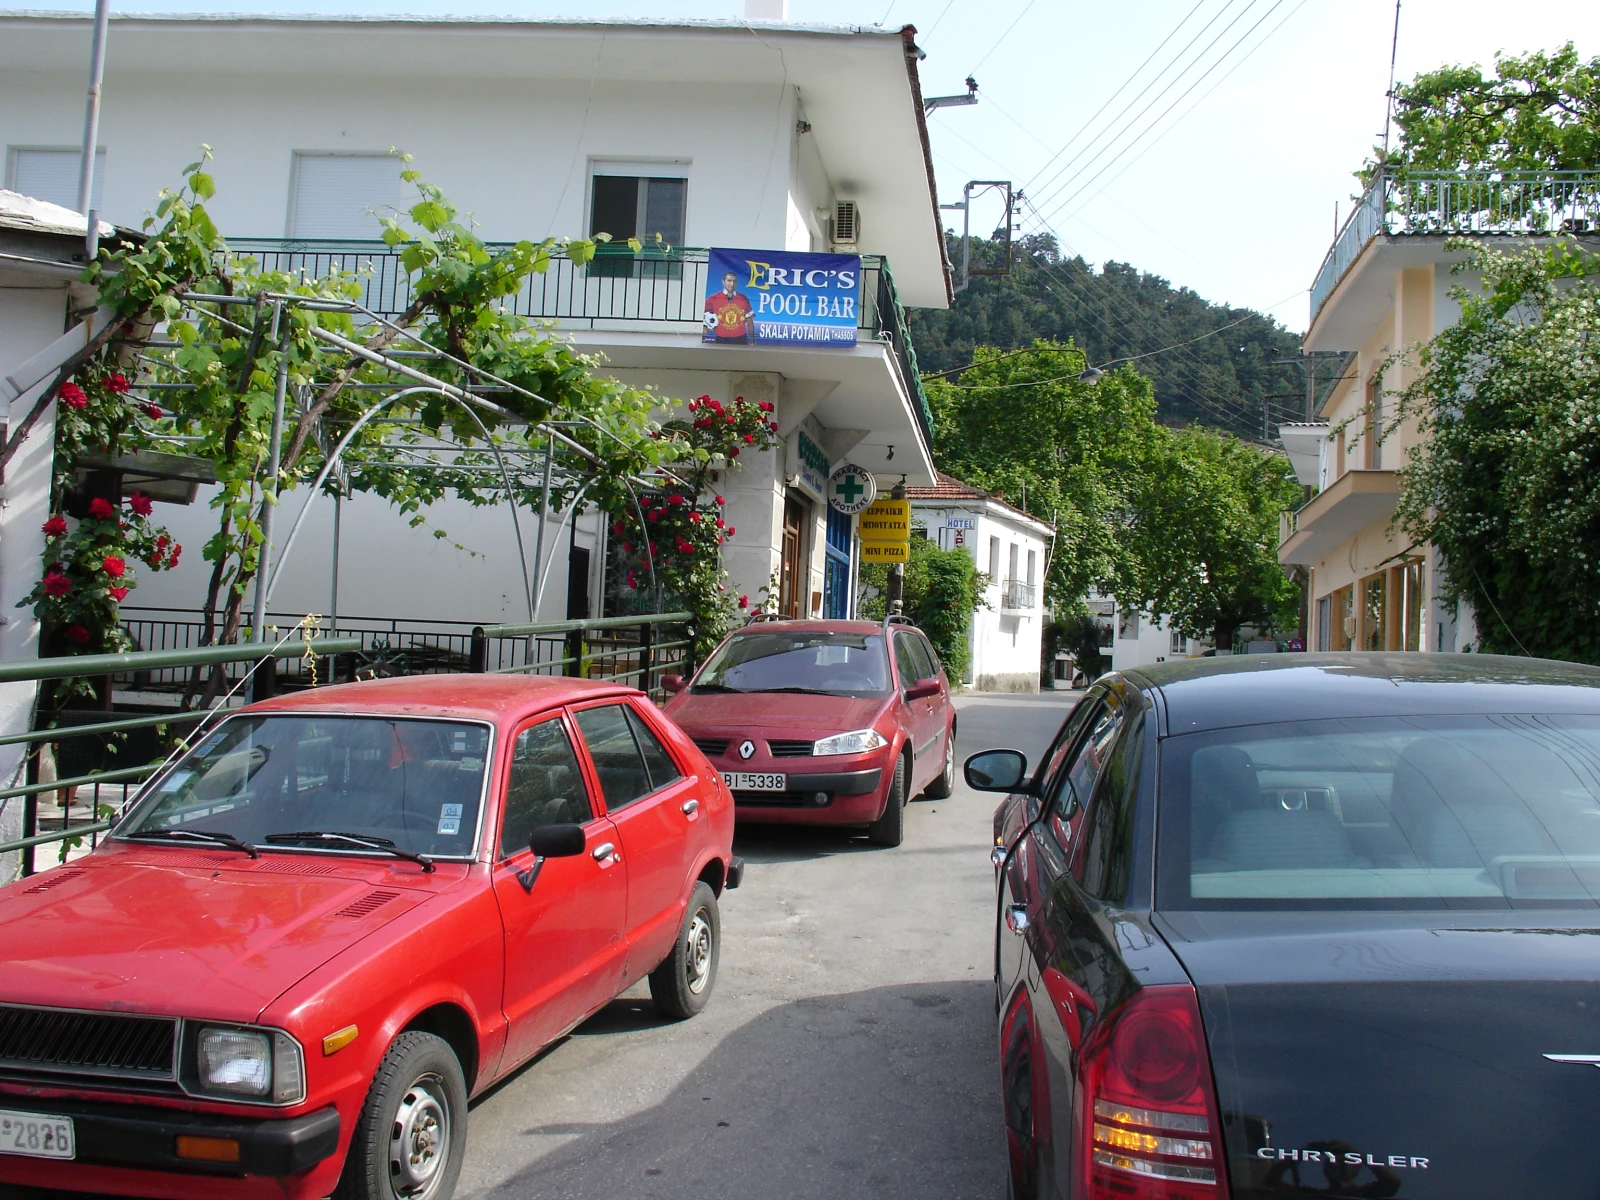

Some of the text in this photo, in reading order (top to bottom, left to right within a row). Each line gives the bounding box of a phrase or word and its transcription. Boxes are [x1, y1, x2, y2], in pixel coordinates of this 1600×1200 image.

[745, 260, 855, 290] ERIC'S
[758, 293, 812, 316] POOL
[816, 296, 855, 318] BAR
[760, 324, 854, 341] SKALA POTAMIA THASSOS
[832, 466, 870, 482] PHARMACY
[831, 497, 868, 512] APOTHEKE
[948, 519, 973, 528] HOTEL
[865, 547, 904, 556] MINI PIZZA
[1257, 1147, 1430, 1169] CHRYSLER
